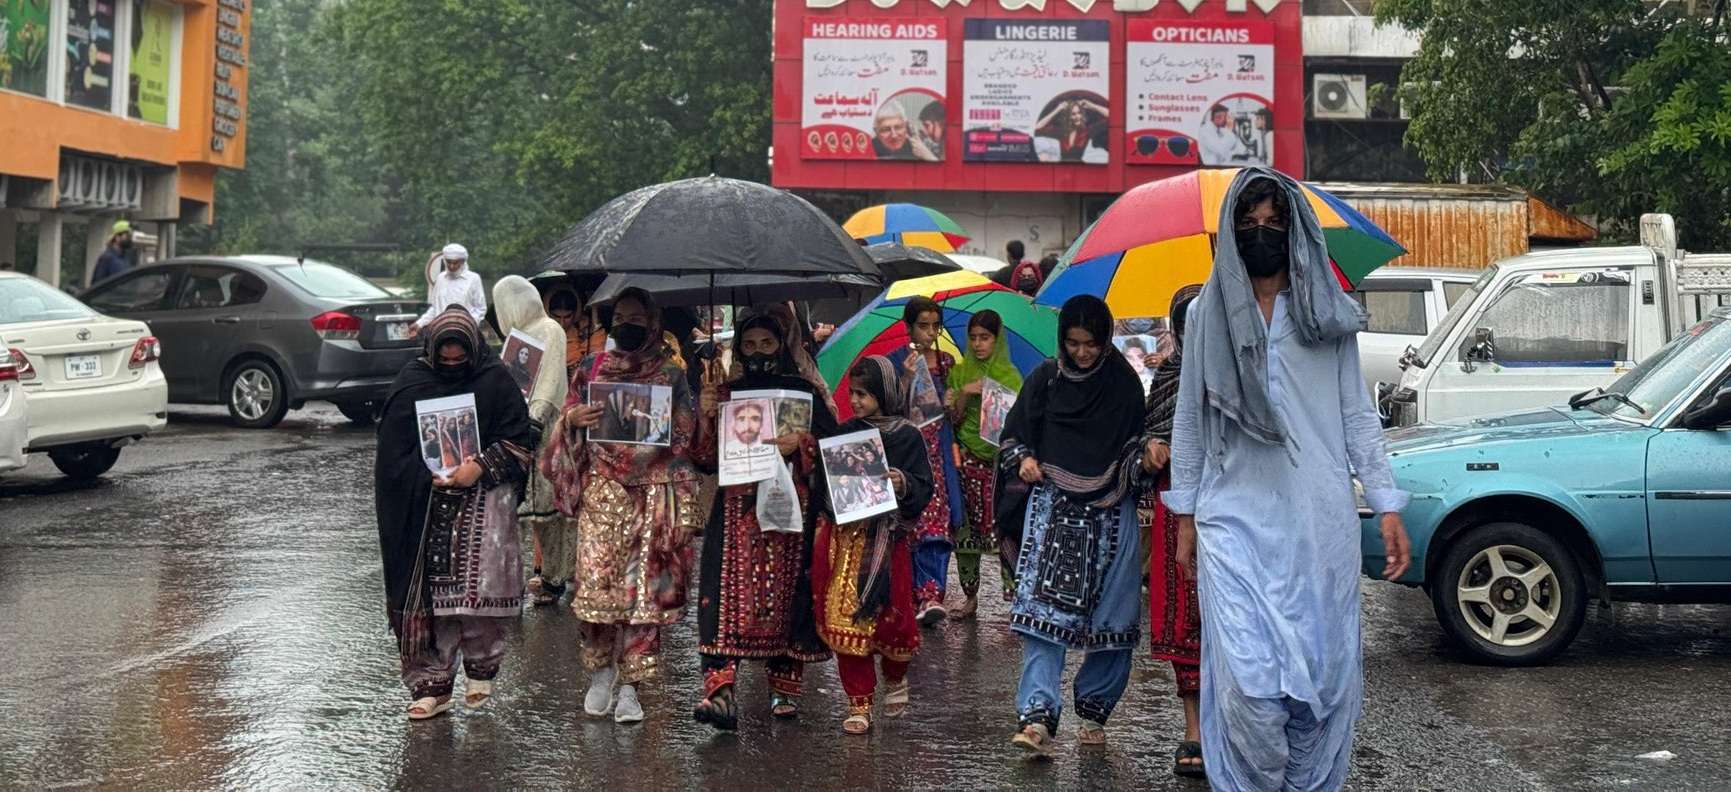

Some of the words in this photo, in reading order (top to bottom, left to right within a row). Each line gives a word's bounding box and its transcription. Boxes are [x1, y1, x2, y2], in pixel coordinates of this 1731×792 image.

[811, 23, 893, 39] HEARING
[895, 23, 938, 39] AIDS
[995, 26, 1078, 40] LINGERIE
[1151, 27, 1250, 43] OPTICIANS
[1148, 93, 1185, 101] Contact
[1186, 94, 1208, 102] Lens
[1148, 104, 1201, 113] Sunglasses
